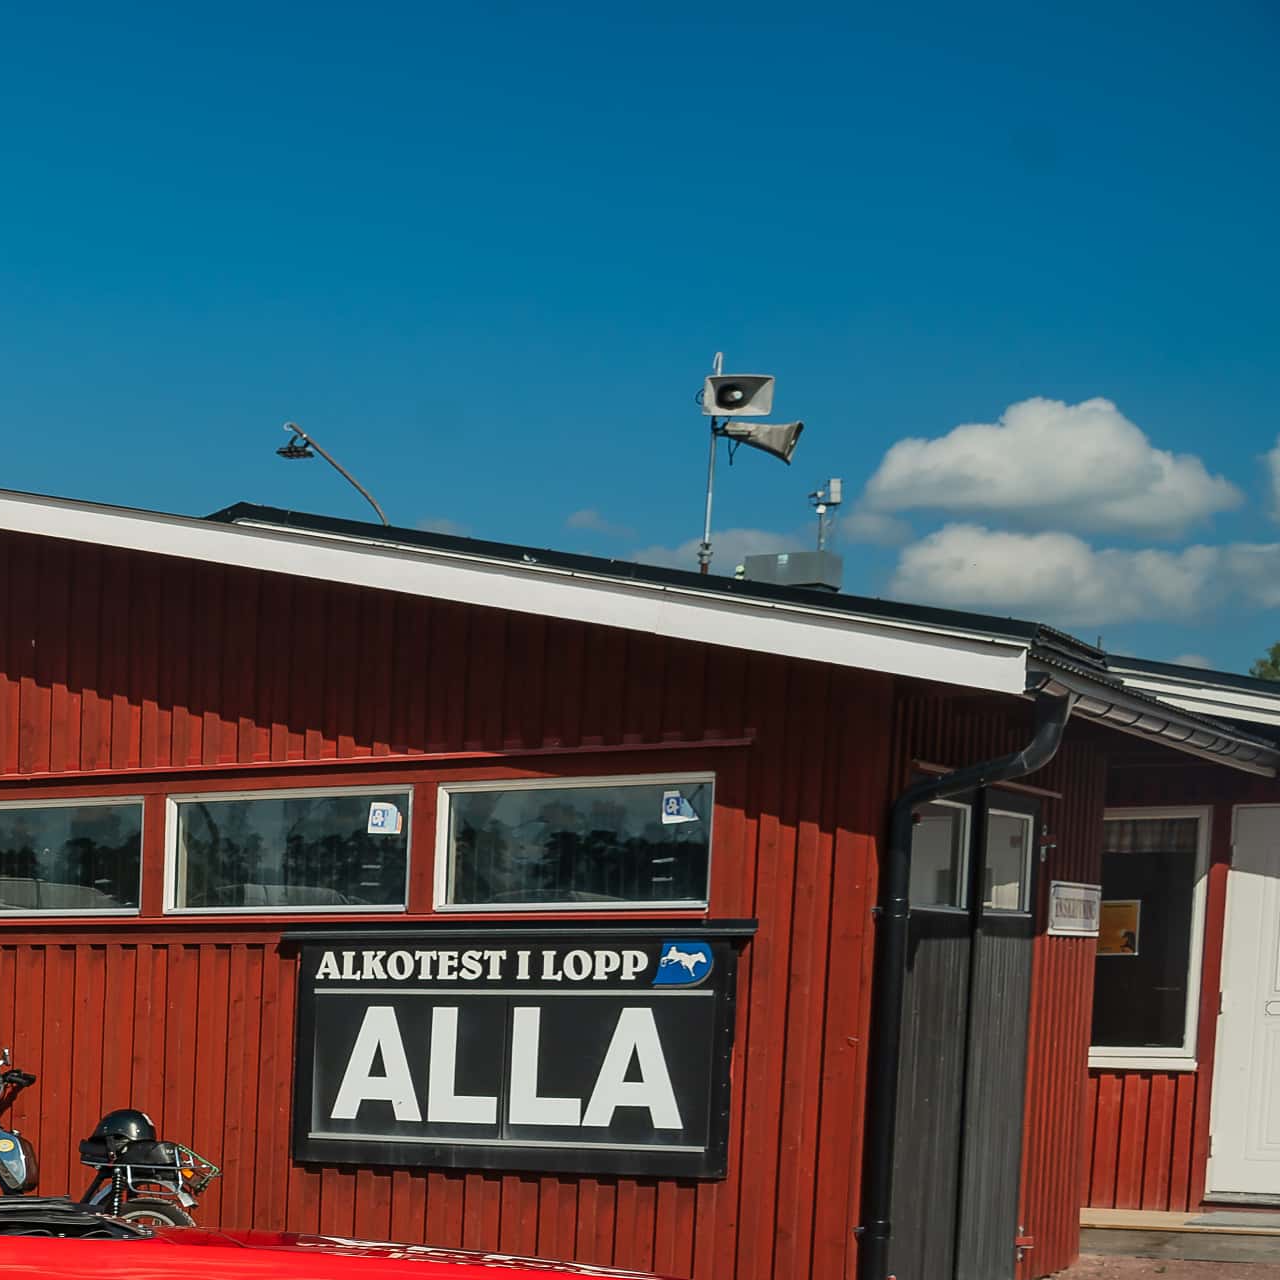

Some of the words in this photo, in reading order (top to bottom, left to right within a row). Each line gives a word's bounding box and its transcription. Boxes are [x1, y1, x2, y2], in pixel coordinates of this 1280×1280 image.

[315, 950, 506, 981] ALKOTEST
[517, 950, 532, 980] I
[540, 950, 649, 981] LOPP
[330, 1006, 684, 1130] ALLA
